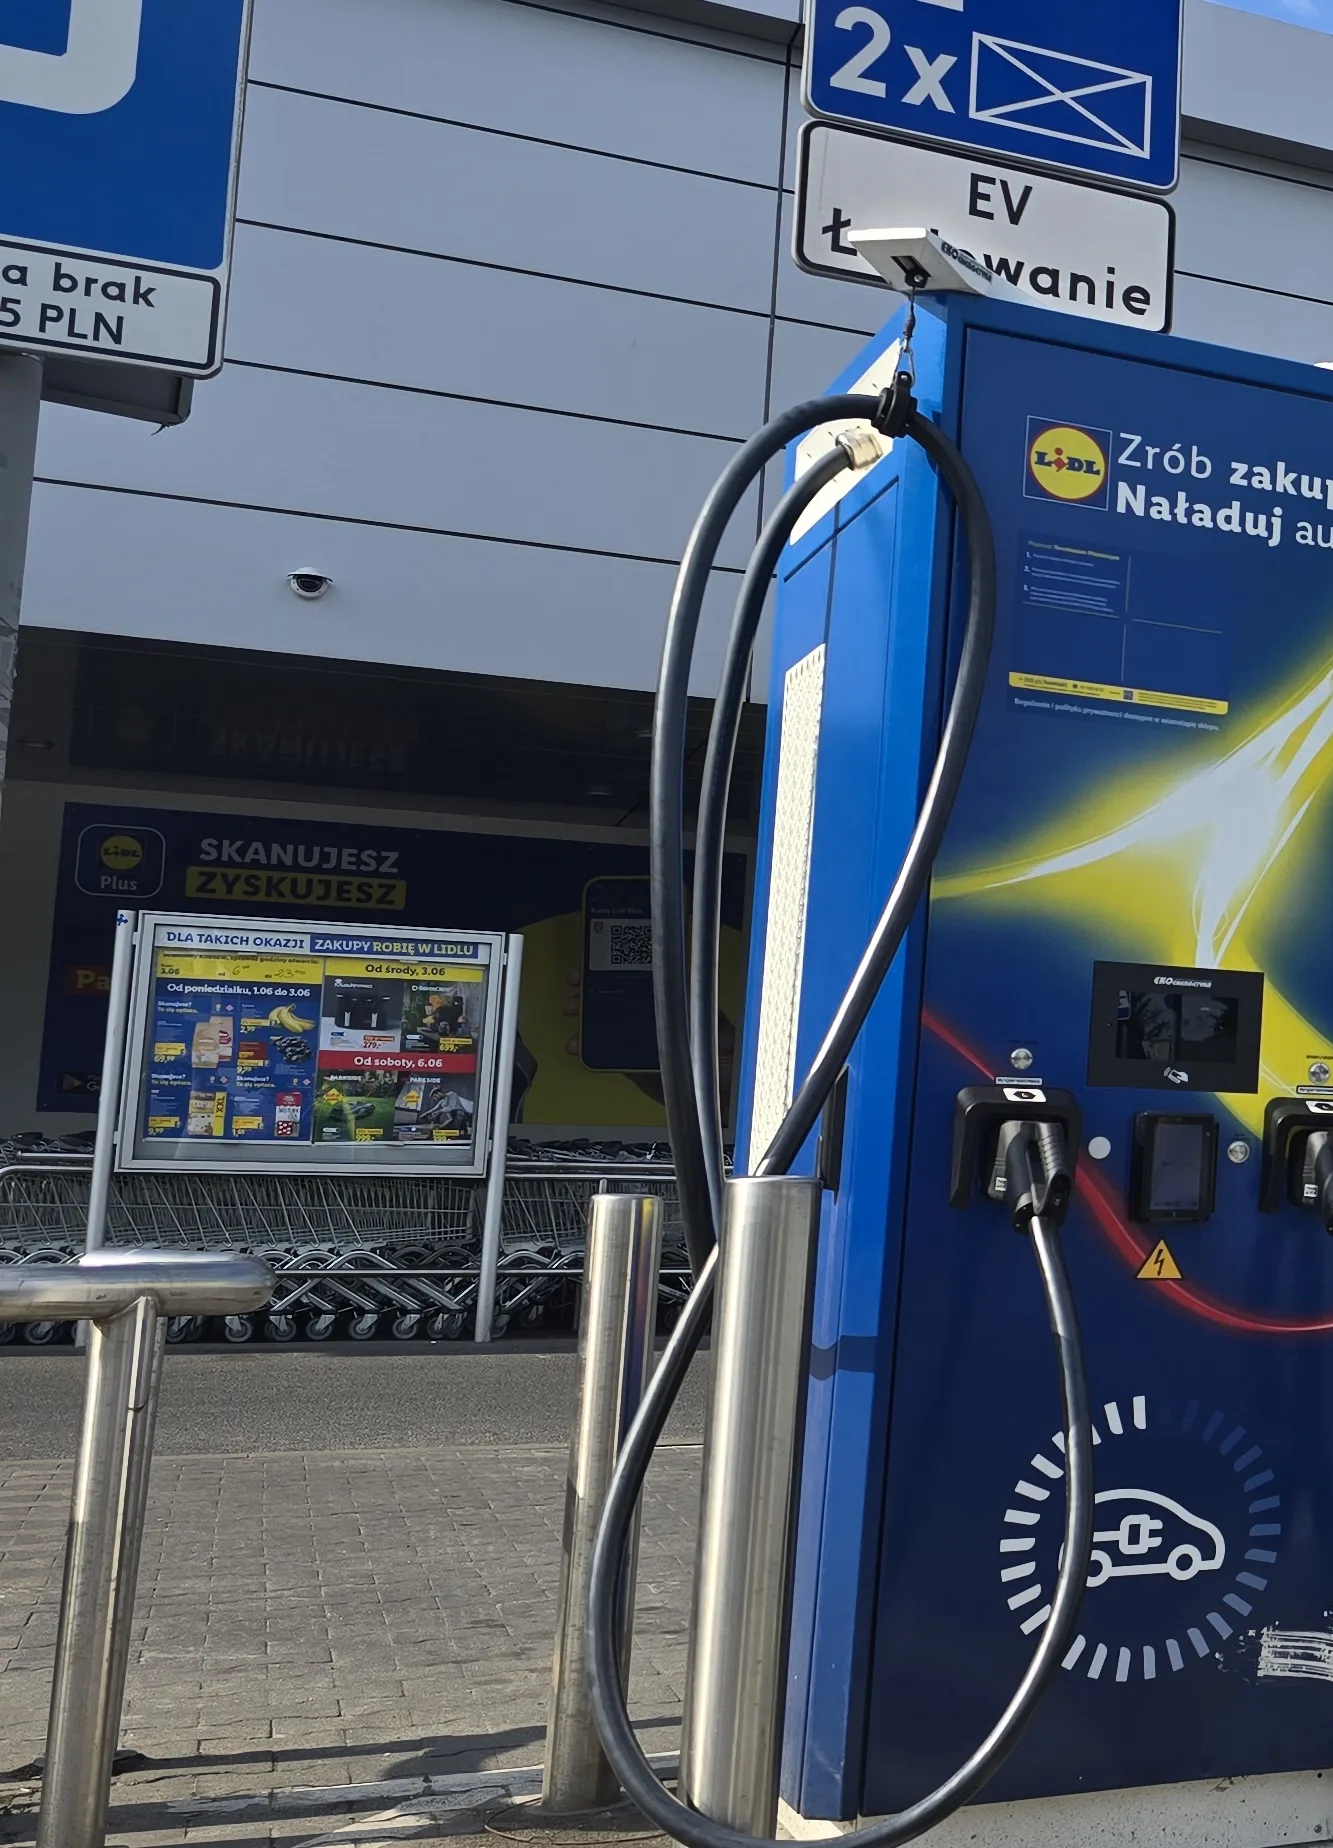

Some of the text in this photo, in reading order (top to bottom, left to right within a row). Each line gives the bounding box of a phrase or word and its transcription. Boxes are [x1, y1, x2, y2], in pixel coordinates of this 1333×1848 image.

[968, 172, 1033, 226] EV
[821, 206, 1152, 316] Łwanie
[52, 261, 157, 308] brak
[38, 302, 125, 346] PLN
[1117, 431, 1213, 479] Zrób
[1116, 481, 1284, 547] Naładuj
[199, 838, 400, 874] SKANUJESZ
[100, 875, 138, 892] Plus
[195, 871, 398, 906] ZYSKUJESZ
[166, 931, 474, 956] DLA TAKICH OKAZJI ZAKUPY ROBIĘ W LIDLU
[365, 964, 446, 977] Od środy, 3.06
[166, 982, 311, 997] Od poniedziałku, 1.06 do 3.06
[353, 1056, 443, 1069] Od soboty, 6.06
